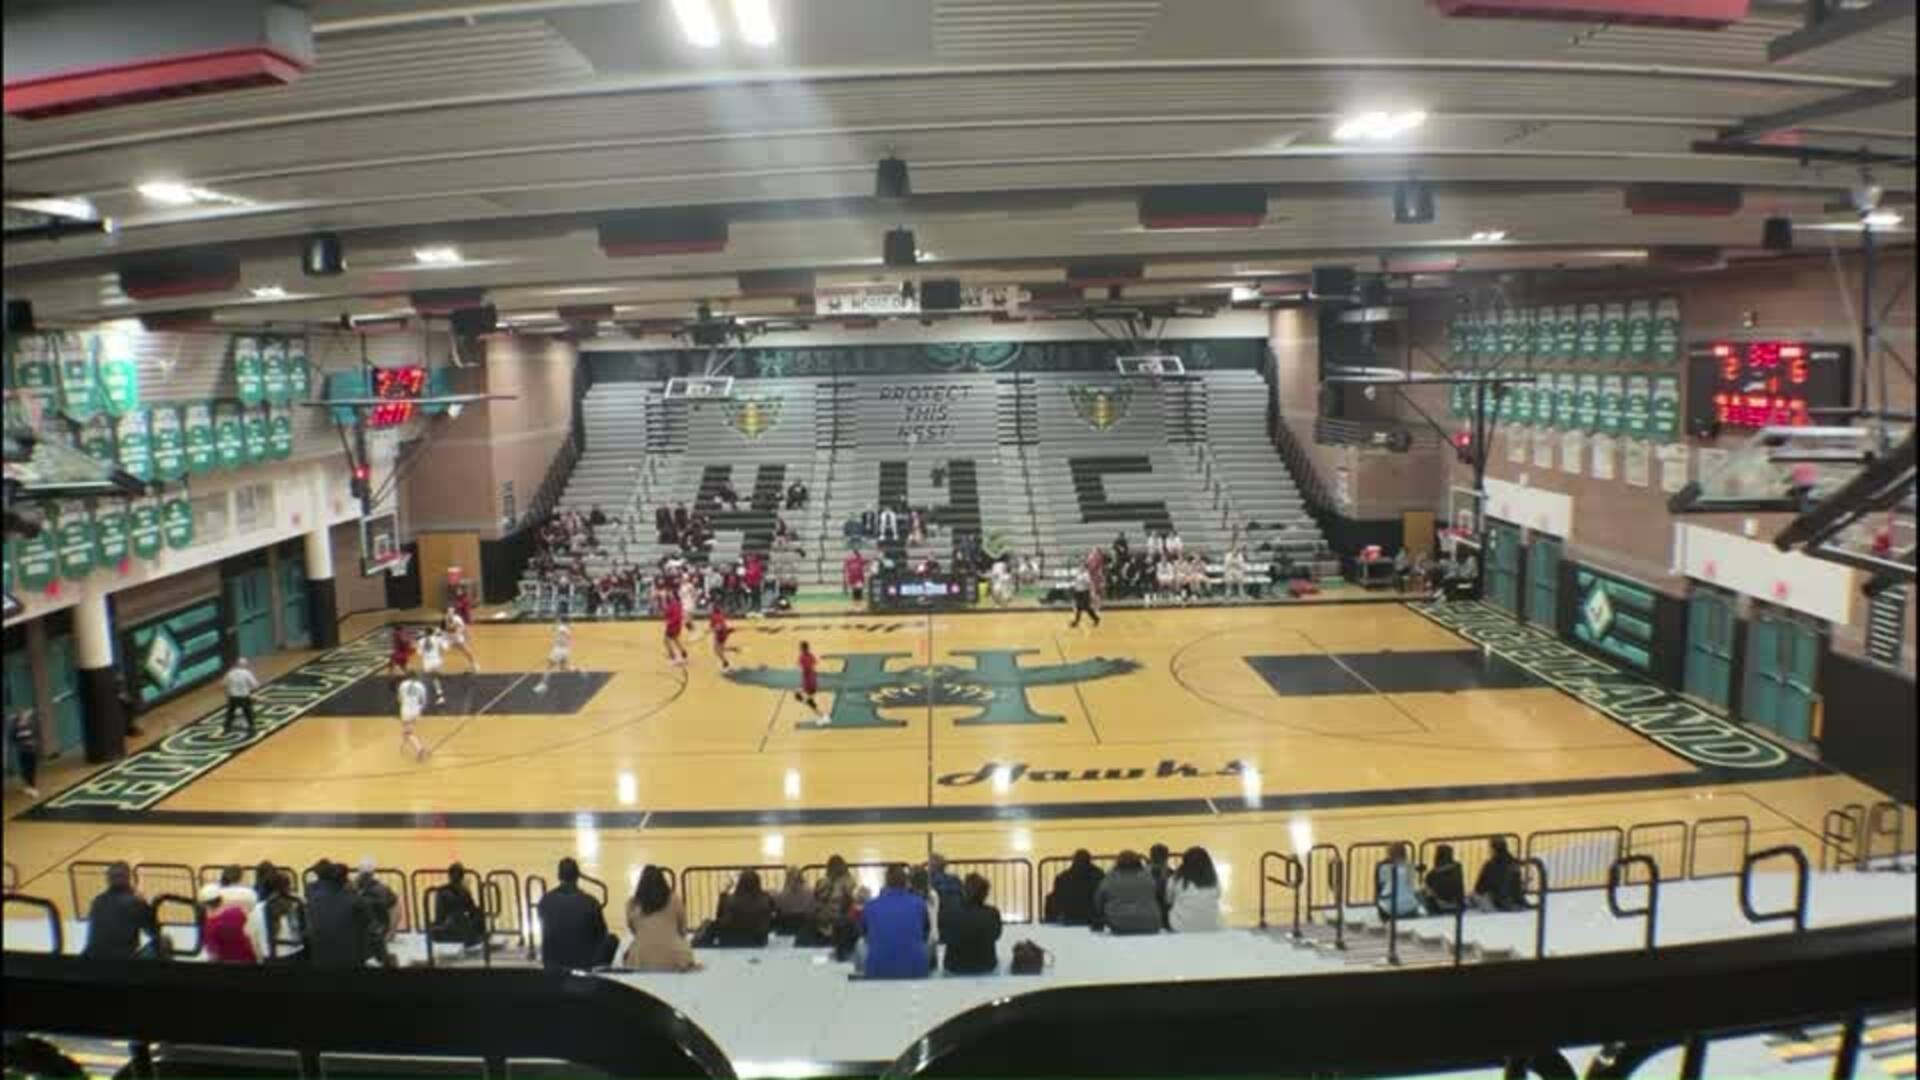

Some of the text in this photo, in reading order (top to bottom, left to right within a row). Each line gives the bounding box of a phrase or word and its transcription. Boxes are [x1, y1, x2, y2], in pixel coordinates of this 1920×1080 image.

[880, 384, 974, 401] PROTECT
[906, 405, 947, 421] THIS
[46, 625, 404, 811] HIGHLAN
[937, 759, 1248, 787] Hawks
